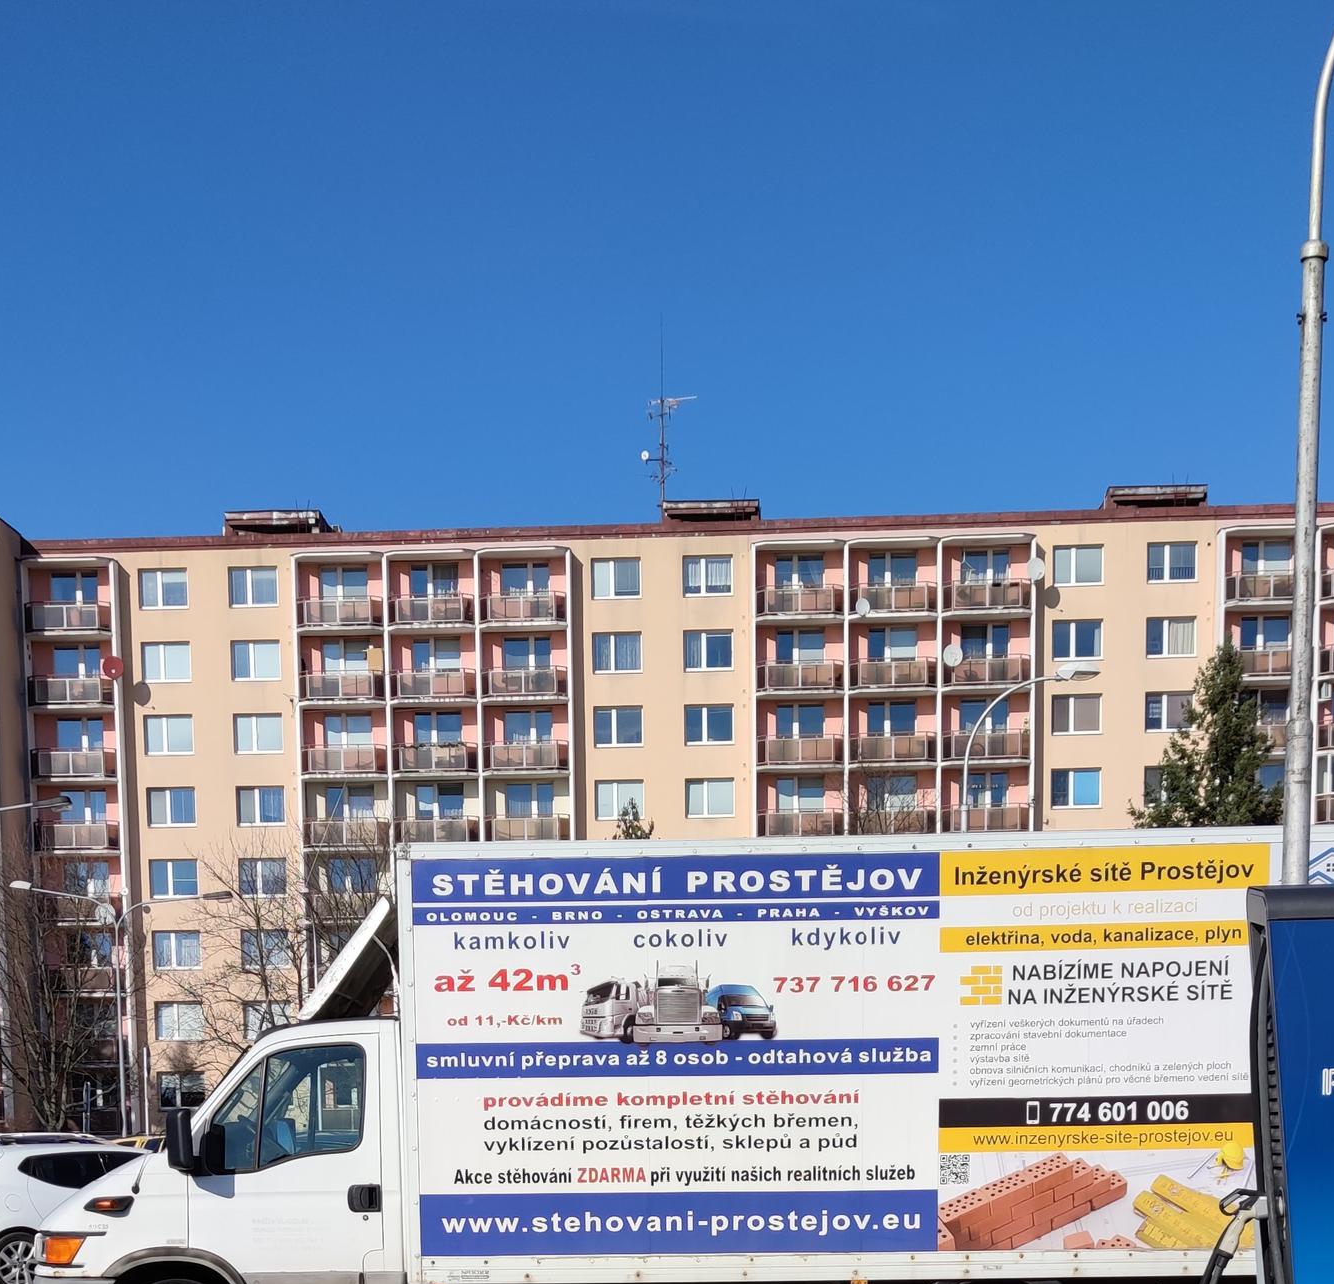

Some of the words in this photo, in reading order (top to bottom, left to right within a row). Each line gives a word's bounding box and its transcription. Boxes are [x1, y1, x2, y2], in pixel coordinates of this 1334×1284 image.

[432, 867, 661, 896] STĚHOVÁNÍ
[688, 864, 922, 896] PROSTĚJOV
[955, 863, 1081, 889] Inženýrské
[1091, 862, 1131, 882] sítě
[1141, 860, 1254, 883] Prostějov
[426, 912, 517, 921] OLOMOUC
[552, 911, 602, 920] BRNO
[637, 909, 723, 919] OSTRAVA
[758, 908, 820, 917] PRAHA
[854, 905, 928, 916] VYŠKOV
[1011, 902, 1033, 919] od
[1039, 901, 1107, 920] projektu
[1113, 900, 1122, 914] k
[1128, 897, 1198, 913] realizaci
[454, 931, 569, 950] kamkoliv
[634, 929, 727, 948] cokoliv
[792, 928, 900, 949] kdykoliv
[966, 931, 1044, 946] elektřina,
[1051, 929, 1096, 945] voda,
[1104, 928, 1198, 942] kanalizace,
[1206, 926, 1241, 943] plyn
[1013, 959, 1113, 981] NABÍZÍME
[1122, 956, 1228, 978] NAPOJENÍ
[434, 969, 476, 993] až
[773, 977, 820, 993] 737
[831, 976, 877, 992] 716
[888, 975, 935, 991] 627
[1008, 989, 1037, 1005] NA
[1044, 983, 1178, 1004] INŽENÝRSKÉ
[1187, 981, 1232, 1000] SÍTĚ
[448, 1016, 467, 1026] od
[475, 1015, 562, 1028] 11,-Kč/km
[427, 1052, 514, 1067] smluvní
[522, 1051, 619, 1070] přeprava
[626, 1050, 651, 1065] až
[656, 1050, 667, 1065] 8
[674, 1050, 728, 1064] osob
[748, 1048, 852, 1064] odtahová
[859, 1047, 931, 1062] služba
[484, 1093, 608, 1111] provádíme
[617, 1091, 734, 1109] kompletní
[743, 1089, 859, 1105] stěhování
[1048, 1101, 1091, 1122] 774
[1098, 1101, 1138, 1121] 601
[1147, 1100, 1190, 1120] 006
[484, 1115, 611, 1132] domácností,
[620, 1115, 677, 1131] firem,
[685, 1114, 765, 1132] těžkých
[774, 1113, 857, 1129] břemen,
[484, 1136, 574, 1155] vyklízení
[583, 1135, 714, 1154] pozůstalostí,
[723, 1134, 791, 1152] sklepů
[800, 1138, 810, 1148] a
[819, 1133, 857, 1152] půd
[973, 1129, 1233, 1148] www.inzenyrske-site-prostejov.eu
[454, 1169, 492, 1184] Akce
[498, 1168, 571, 1184] stěhování
[578, 1168, 646, 1183] ZDARMA
[651, 1167, 670, 1186] při
[676, 1167, 725, 1186] využití
[732, 1166, 781, 1181] našich
[788, 1165, 860, 1181] realitních
[866, 1165, 915, 1180] služeb
[442, 1210, 920, 1236] www.stehovani-prostejov.eu
